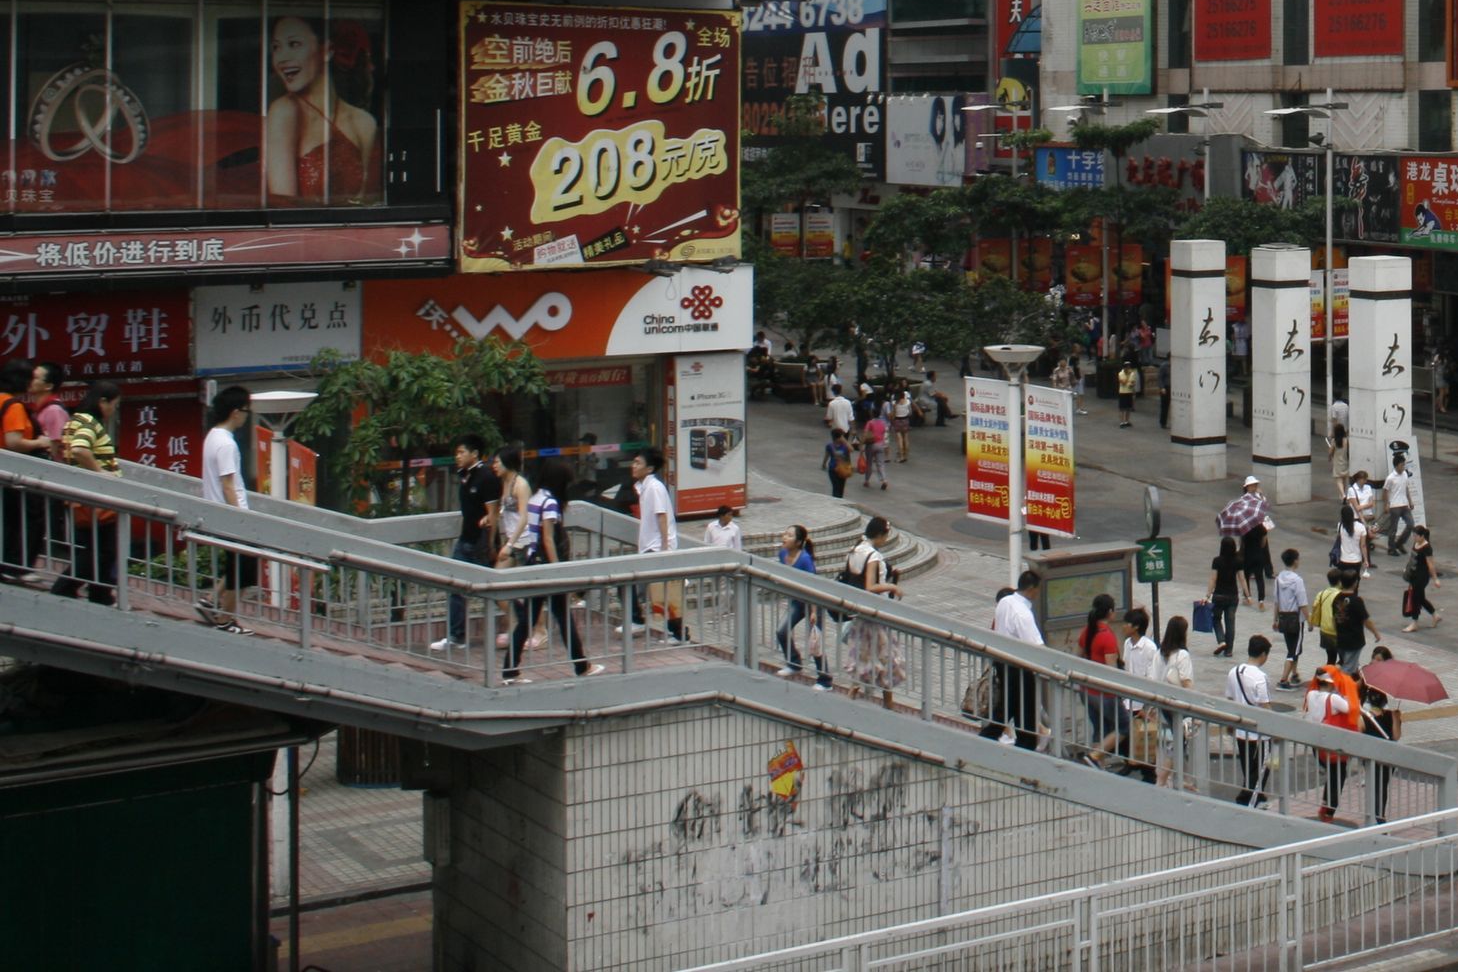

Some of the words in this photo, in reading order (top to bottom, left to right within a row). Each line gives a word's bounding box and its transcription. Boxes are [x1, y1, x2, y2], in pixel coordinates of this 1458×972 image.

[484, 33, 573, 66] 空前绝后
[697, 26, 731, 48] 全场
[795, 28, 880, 95] Ad
[484, 69, 573, 103] 金秋巨献
[467, 119, 543, 153] 千足黄金
[36, 238, 225, 268] 将低价进行到底
[1, 307, 170, 360] 外贸鞋
[210, 302, 349, 335] 外币代兑点
[643, 313, 675, 326] China
[643, 325, 685, 335] unicom
